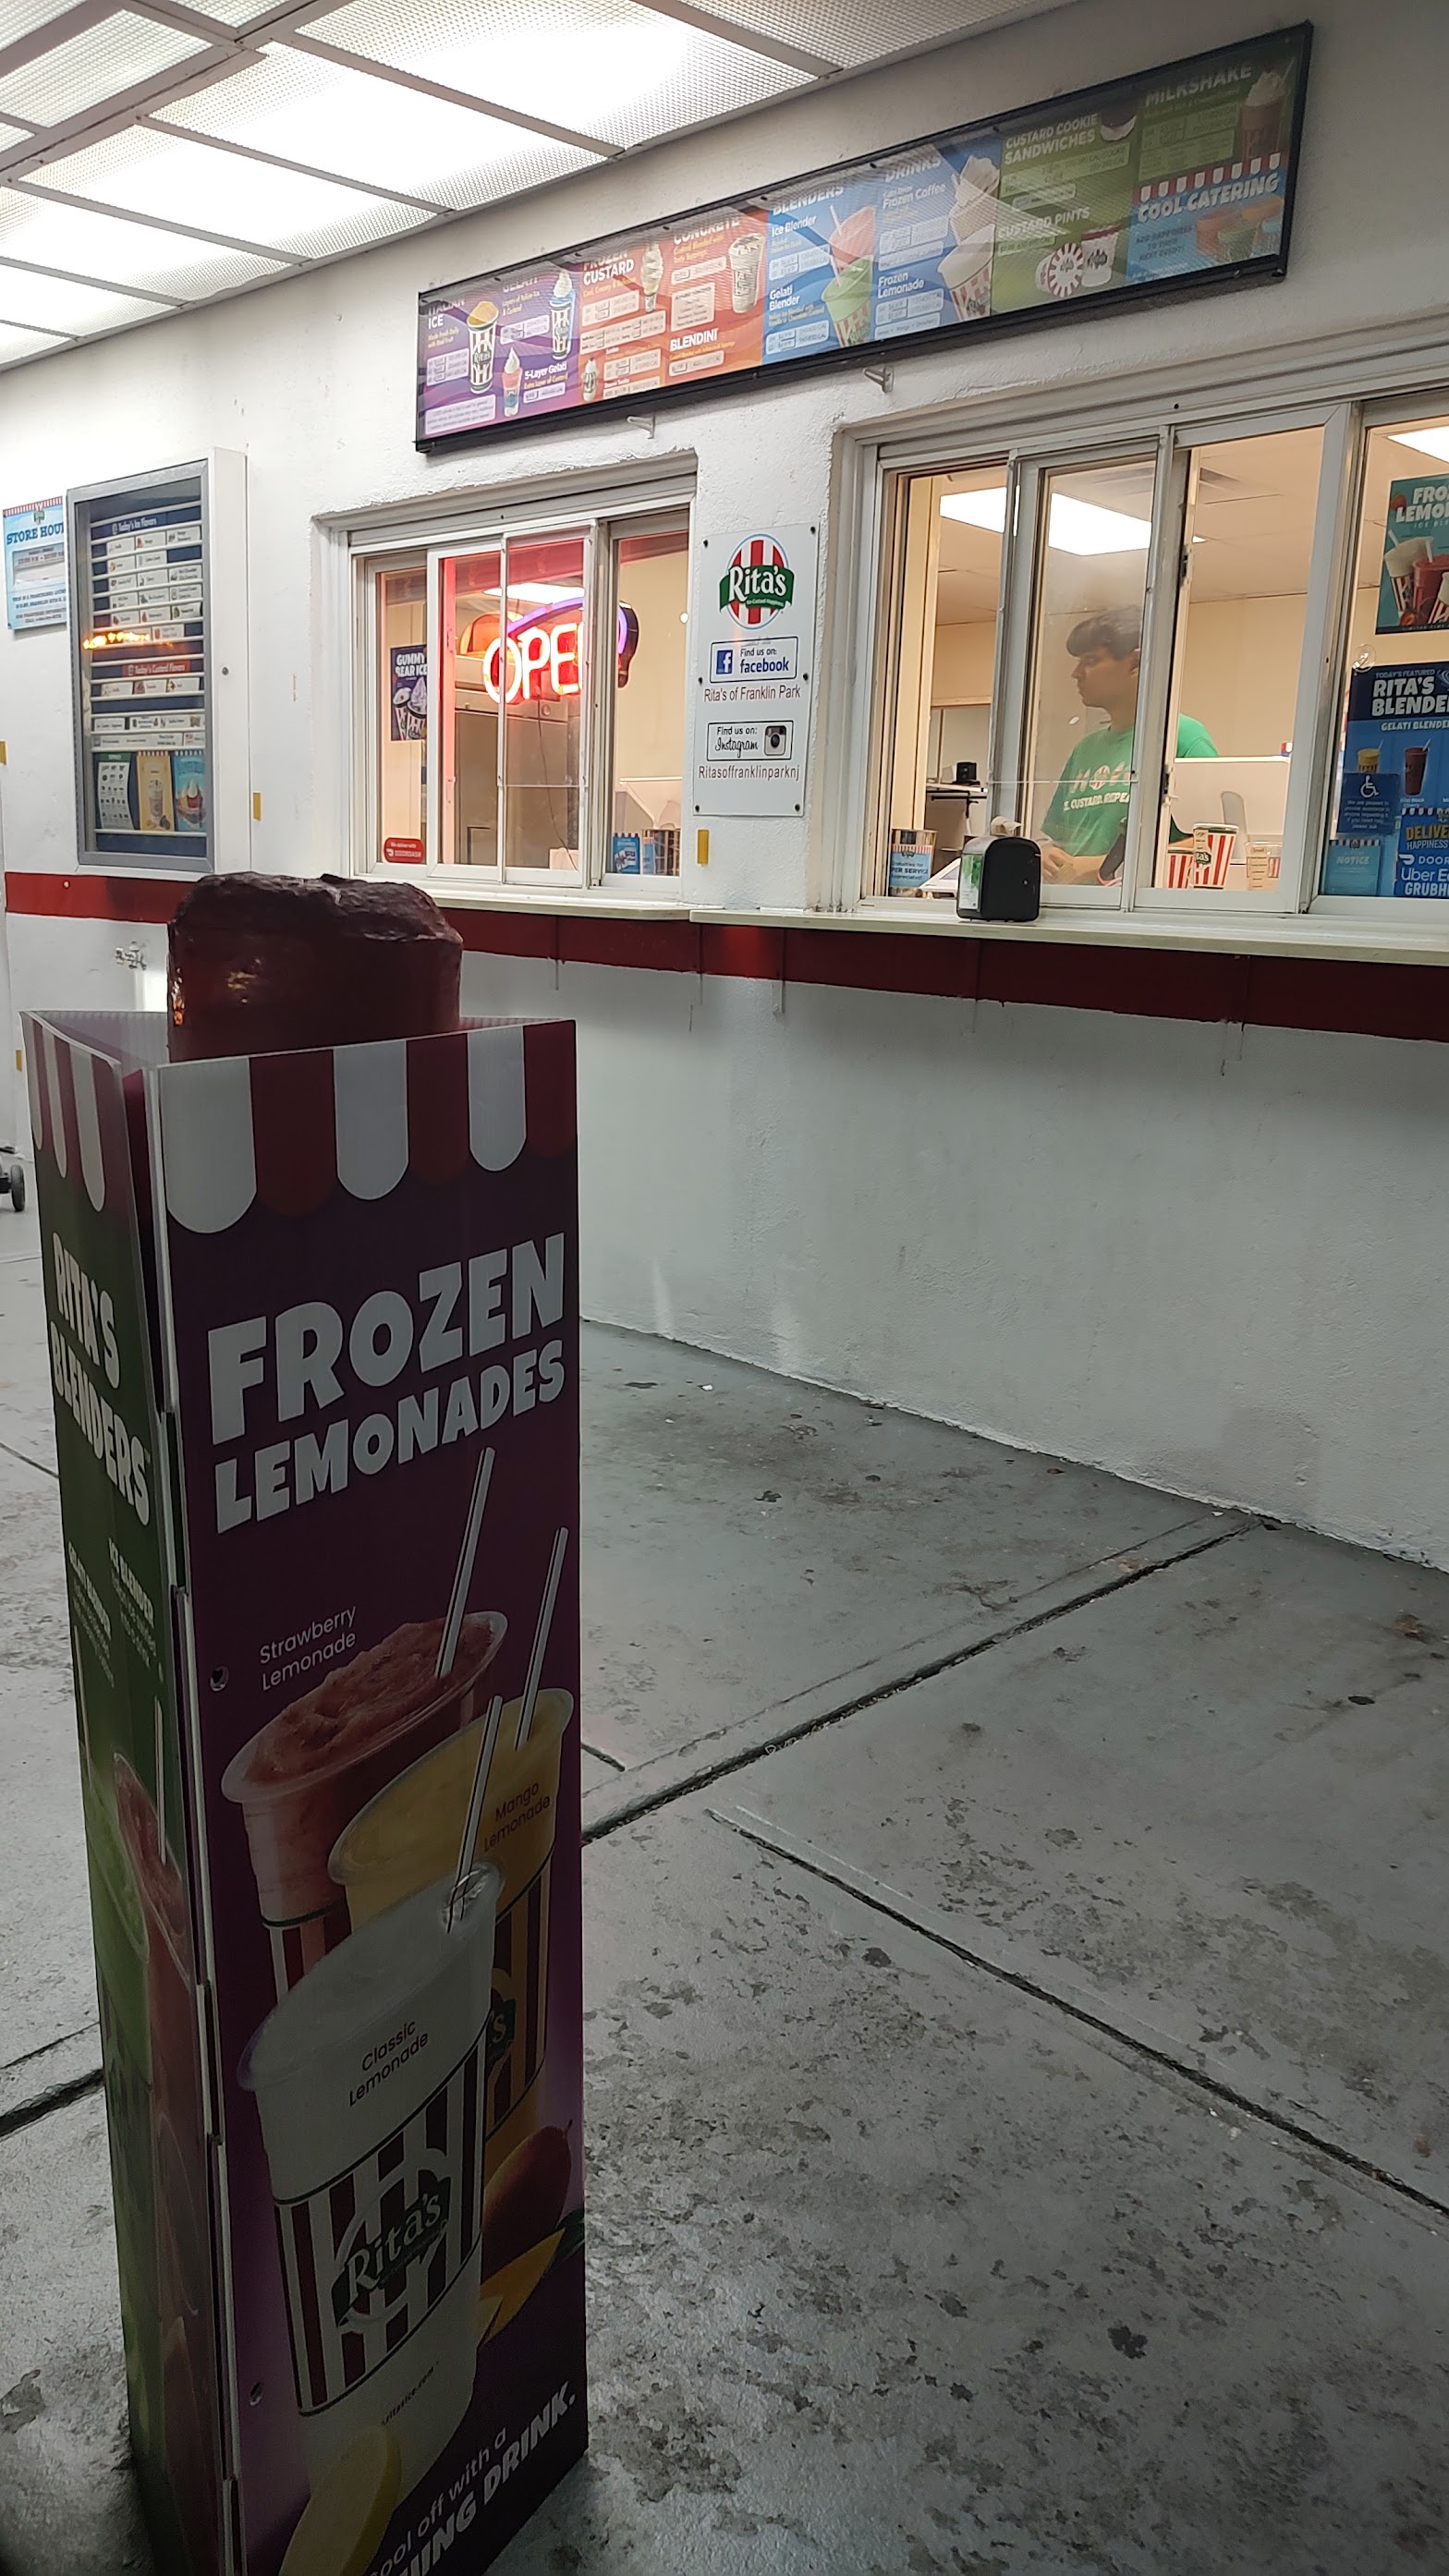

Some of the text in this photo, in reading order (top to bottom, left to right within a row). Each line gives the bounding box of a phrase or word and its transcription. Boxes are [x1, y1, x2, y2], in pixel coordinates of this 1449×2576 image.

[1145, 65, 1252, 106] MILKSHAKE
[1005, 112, 1098, 149] CUSTARD COOKIE
[1005, 128, 1096, 165] SANDWICHES
[883, 192, 913, 209] Frozen
[1138, 173, 1280, 223] COOL CATERING
[772, 215, 816, 237] Ice Blender
[1054, 205, 1090, 225] PINTS
[583, 259, 635, 286] CUSTARD
[878, 272, 908, 288] Frozen
[769, 284, 793, 300] Gelati
[878, 278, 925, 298] Lemonade
[769, 295, 800, 311] Blender
[428, 314, 444, 330] ICE
[1413, 485, 1449, 504] FRO
[6, 527, 39, 545] STORE
[727, 565, 787, 602] Rita's
[740, 648, 754, 657] Find
[766, 648, 777, 656] on:
[739, 658, 790, 674] facebook
[1403, 669, 1436, 677] FEATURED
[703, 684, 801, 703] Rita's of Franklin Park
[1373, 675, 1435, 698] RITA'S
[1371, 694, 1449, 717] BLENDE
[716, 726, 758, 735] Find us on:
[1381, 721, 1412, 731] GELATI
[714, 737, 759, 759] Instagram
[699, 764, 800, 783] Ritasoffranklinparknj
[1406, 839, 1449, 850] HAPPINESS
[1336, 856, 1370, 865] NOTICE
[1401, 868, 1435, 881] Uber
[52, 1232, 120, 1389] RITA'S
[208, 1233, 565, 1446] FROZEN
[215, 1340, 565, 1534] LEMONADES
[259, 1606, 357, 1665] Strawberry
[262, 1631, 357, 1692] Lemonade
[494, 1780, 540, 1824] Mango
[482, 1795, 551, 1853] Lemonade
[360, 2020, 418, 2072] Classic
[347, 2035, 430, 2108] Lemonade
[347, 2190, 442, 2306] Rita's
[483, 2380, 578, 2506] DRINK.
[371, 2426, 507, 2576] ool off with a
